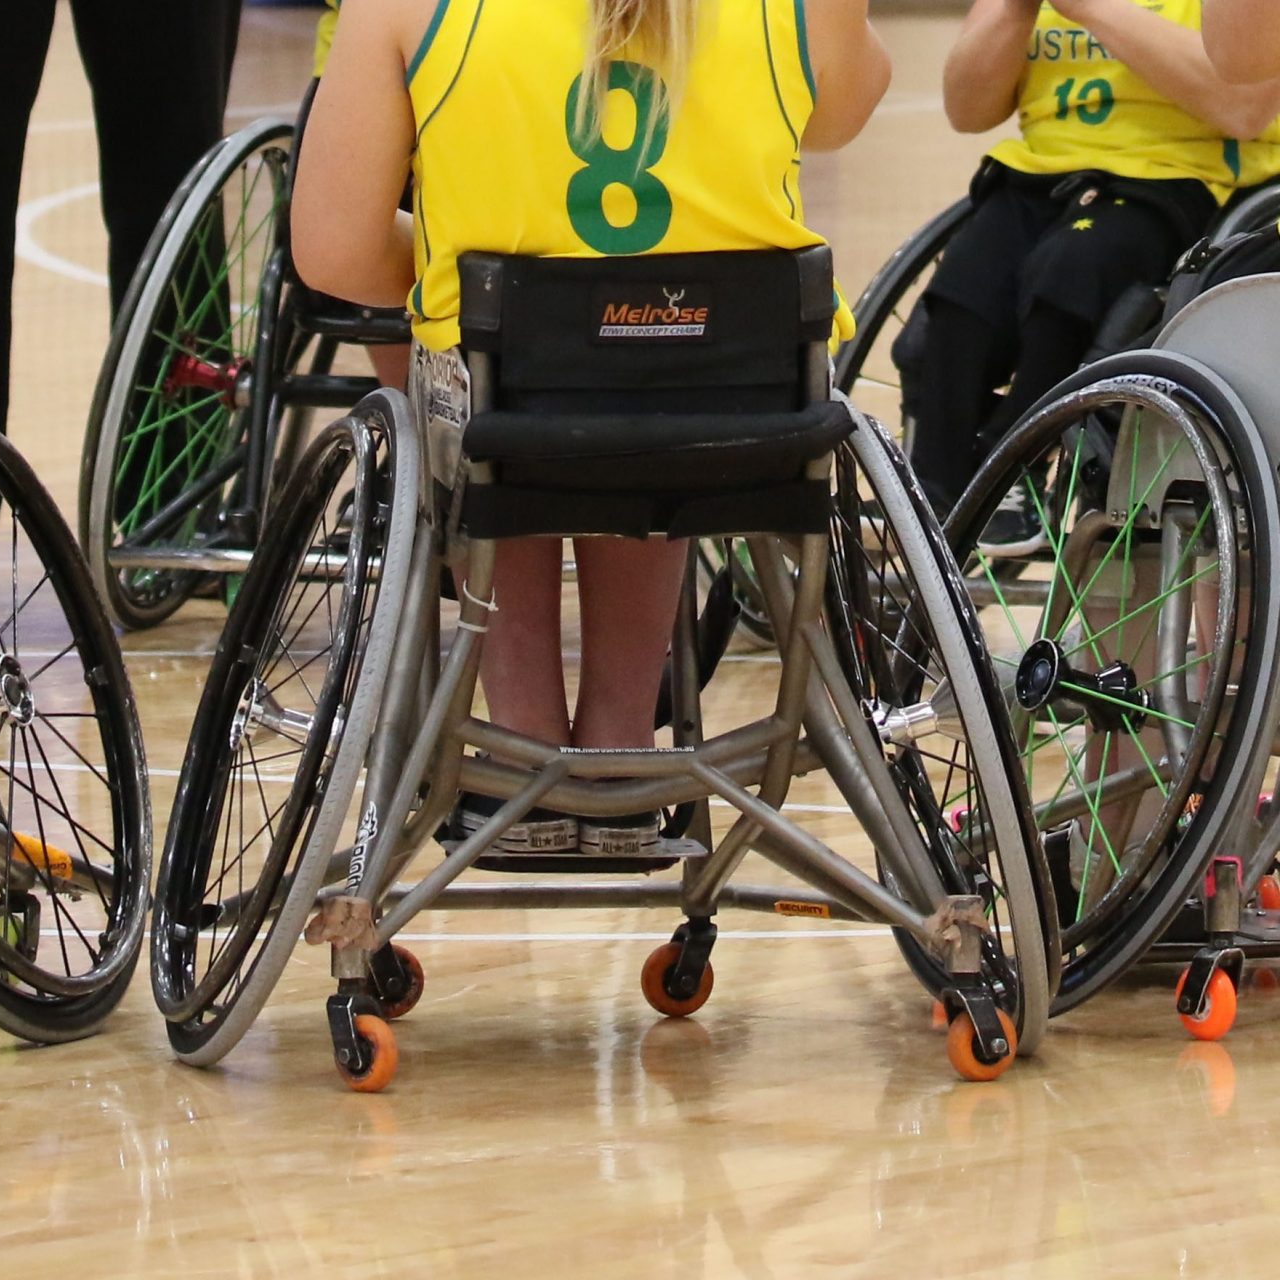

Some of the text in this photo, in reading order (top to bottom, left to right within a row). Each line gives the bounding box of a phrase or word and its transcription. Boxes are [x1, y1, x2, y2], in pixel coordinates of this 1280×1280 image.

[1054, 77, 1115, 126] 10
[565, 60, 672, 255] 8
[602, 303, 708, 324] Melrose
